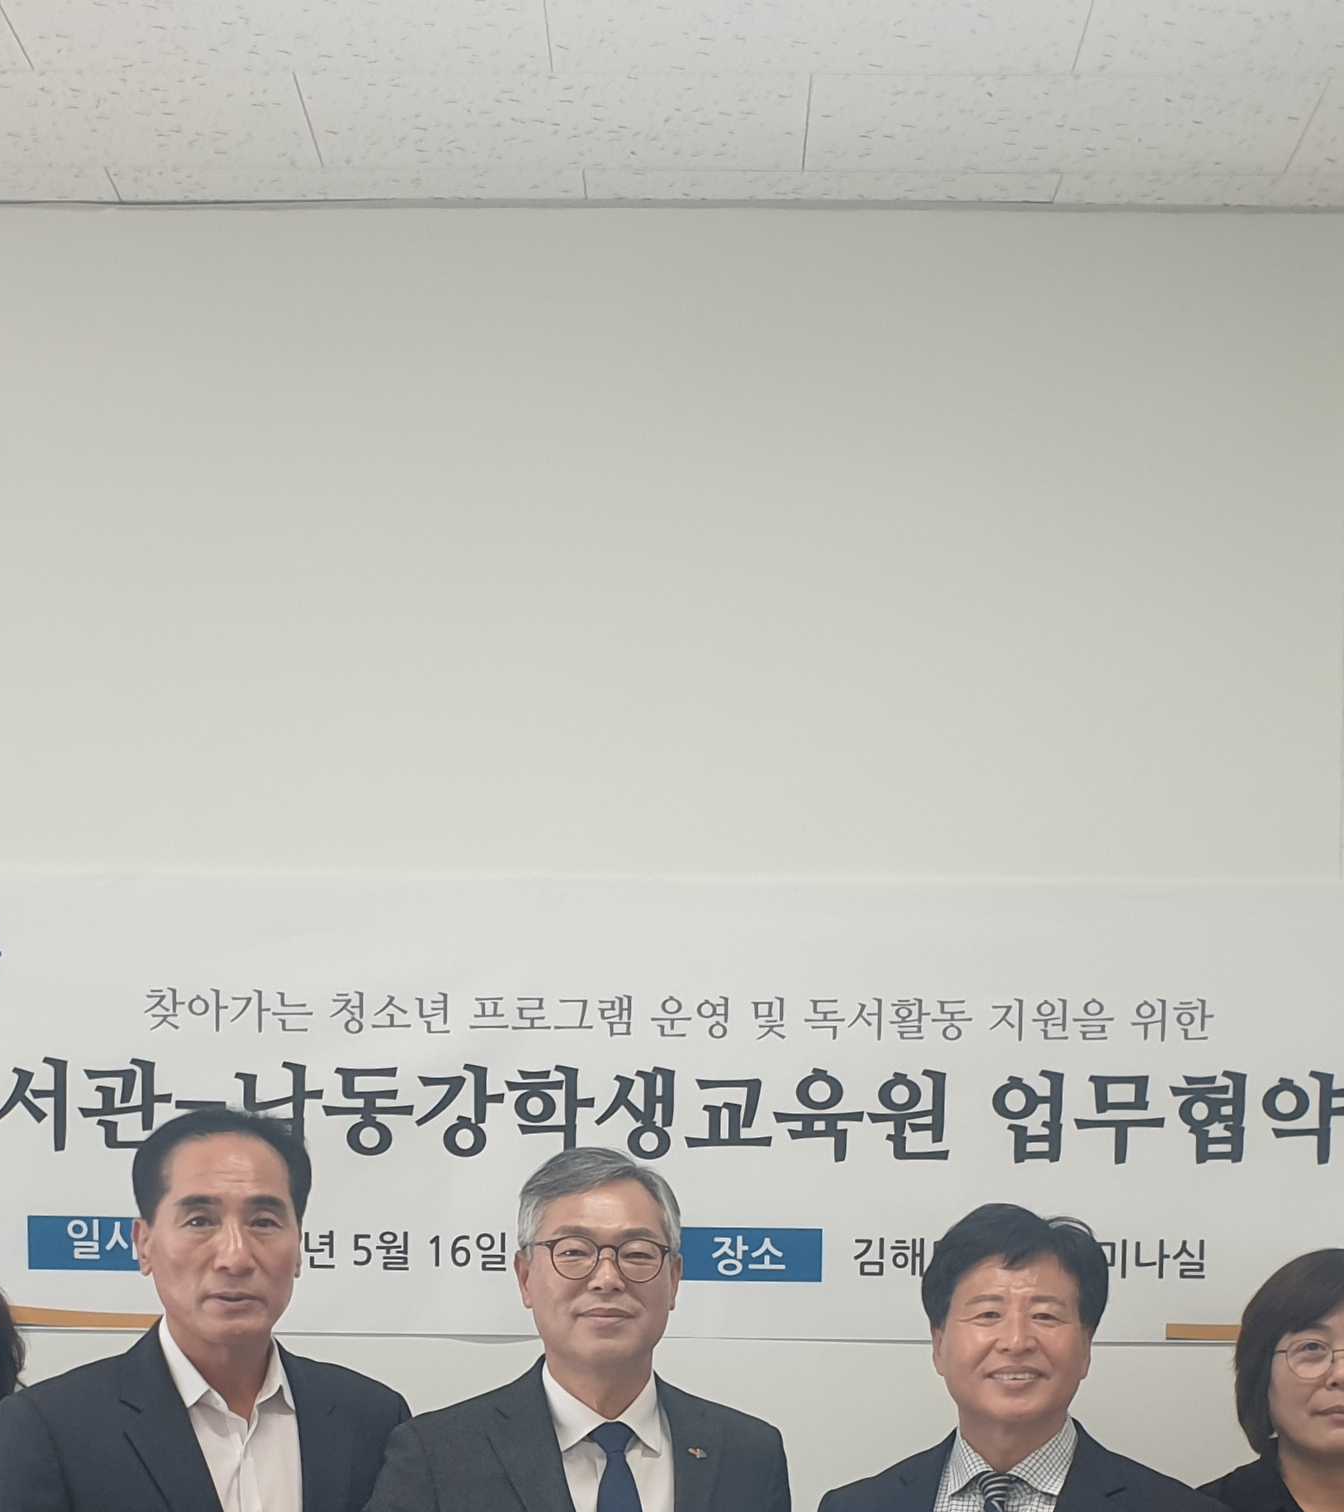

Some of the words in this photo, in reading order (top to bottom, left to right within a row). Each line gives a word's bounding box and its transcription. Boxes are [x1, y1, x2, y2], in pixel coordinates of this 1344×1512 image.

[144, 987, 314, 1033] 찾아가는
[329, 990, 451, 1035] 청소년
[468, 994, 633, 1038] 프로그램
[650, 995, 729, 1040] 운영
[751, 996, 786, 1040] 및
[803, 997, 973, 1041] 독서활동
[989, 997, 1115, 1042] 지원을
[1130, 998, 1215, 1043] 위한
[353, 1231, 410, 1271] 5월
[429, 1232, 507, 1272] 16일
[711, 1235, 787, 1276] 장소
